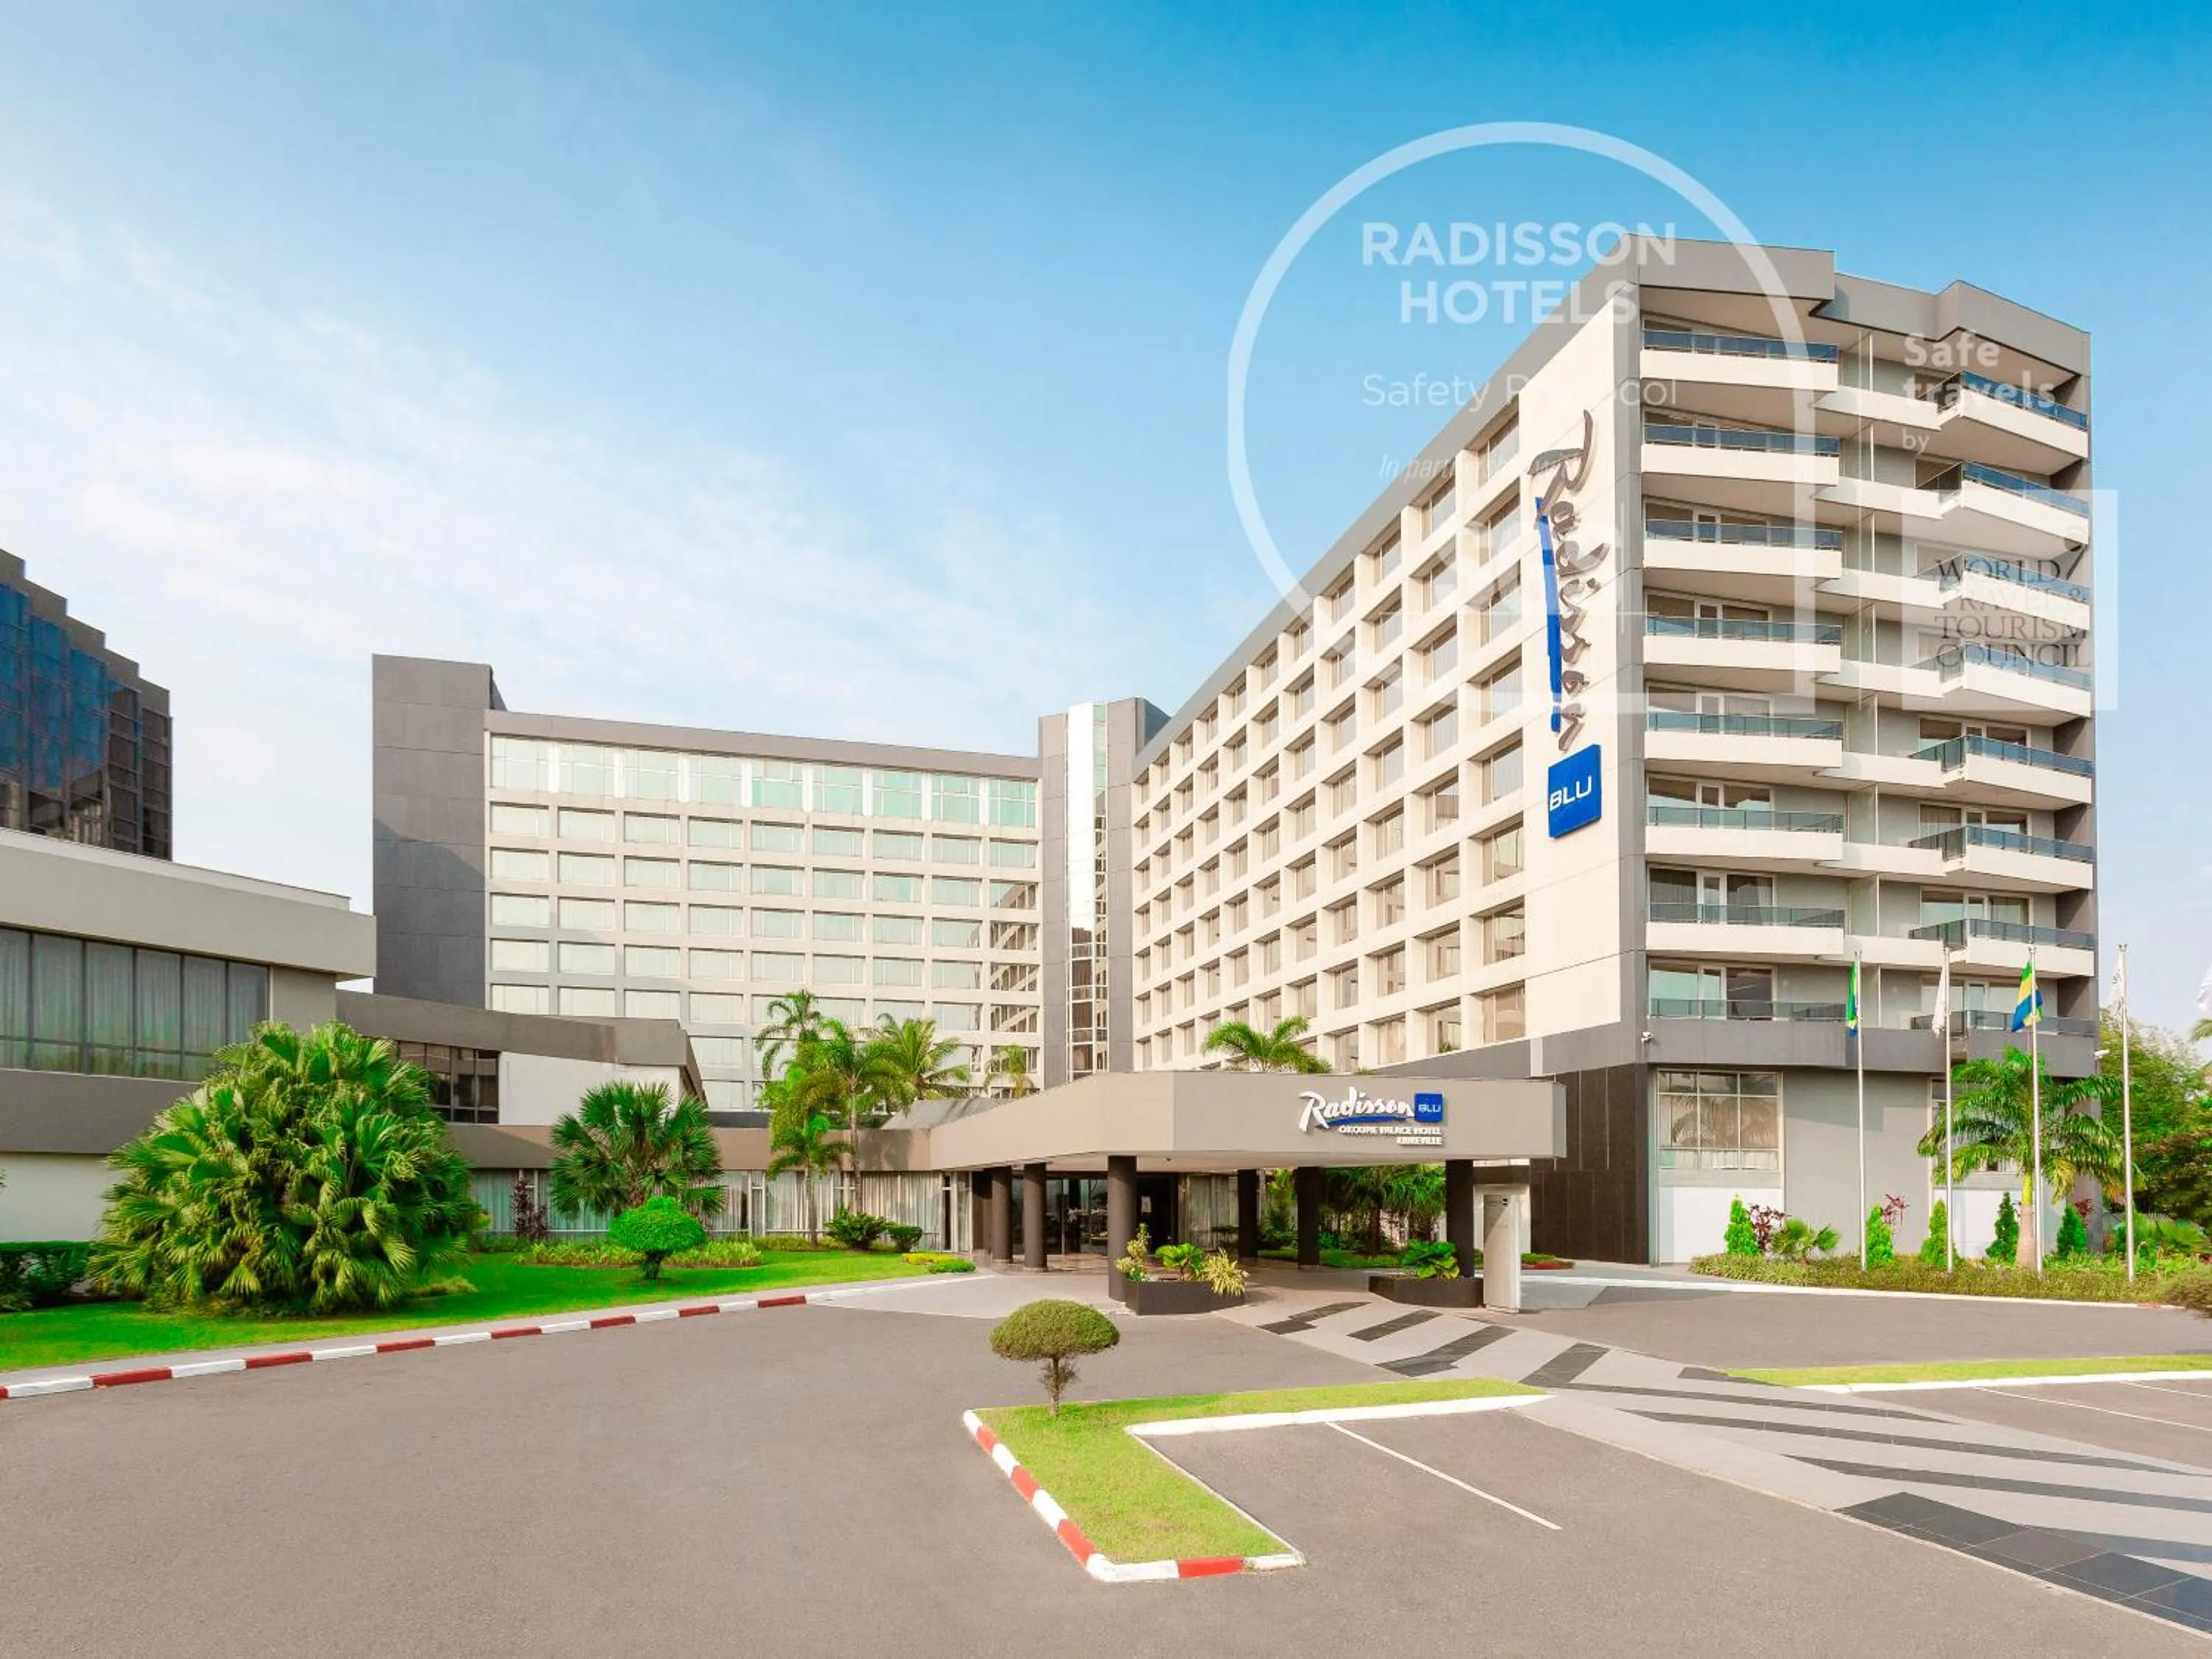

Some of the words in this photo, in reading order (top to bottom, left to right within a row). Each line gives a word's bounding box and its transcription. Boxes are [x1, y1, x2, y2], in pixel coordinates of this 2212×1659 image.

[1527, 408, 1611, 754] Radisson
[1548, 774, 1593, 814] BLU
[1298, 1085, 1414, 1131] Radisson
[1418, 1104, 1441, 1113] BLU
